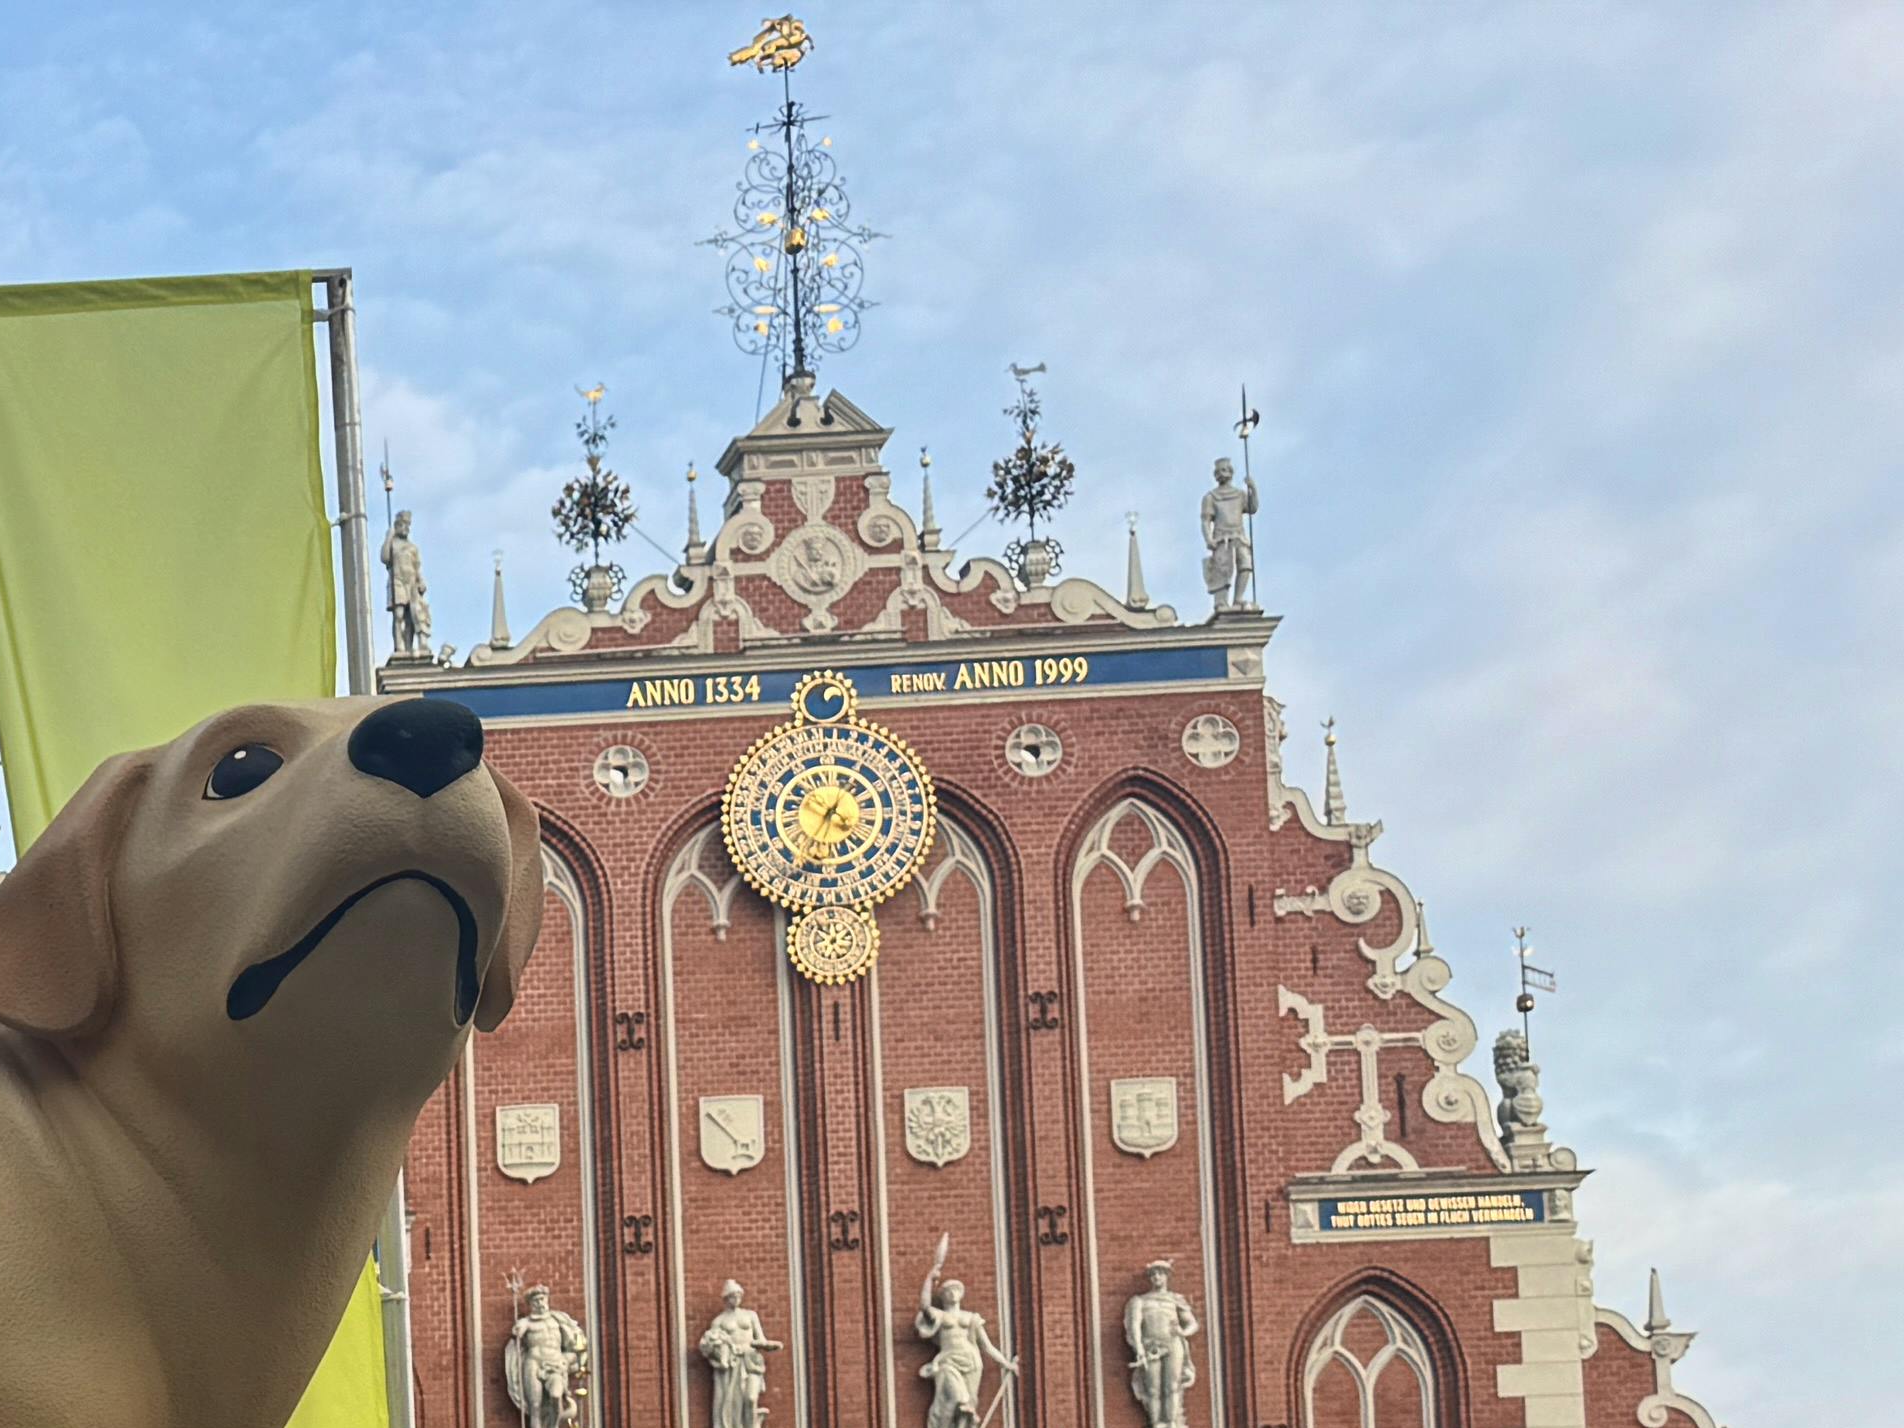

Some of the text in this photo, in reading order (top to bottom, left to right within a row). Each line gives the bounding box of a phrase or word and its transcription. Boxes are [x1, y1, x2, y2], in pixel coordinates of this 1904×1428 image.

[954, 660, 1024, 690] ANNO
[1034, 656, 1089, 685] 1999
[626, 674, 761, 708] ANNO 1334
